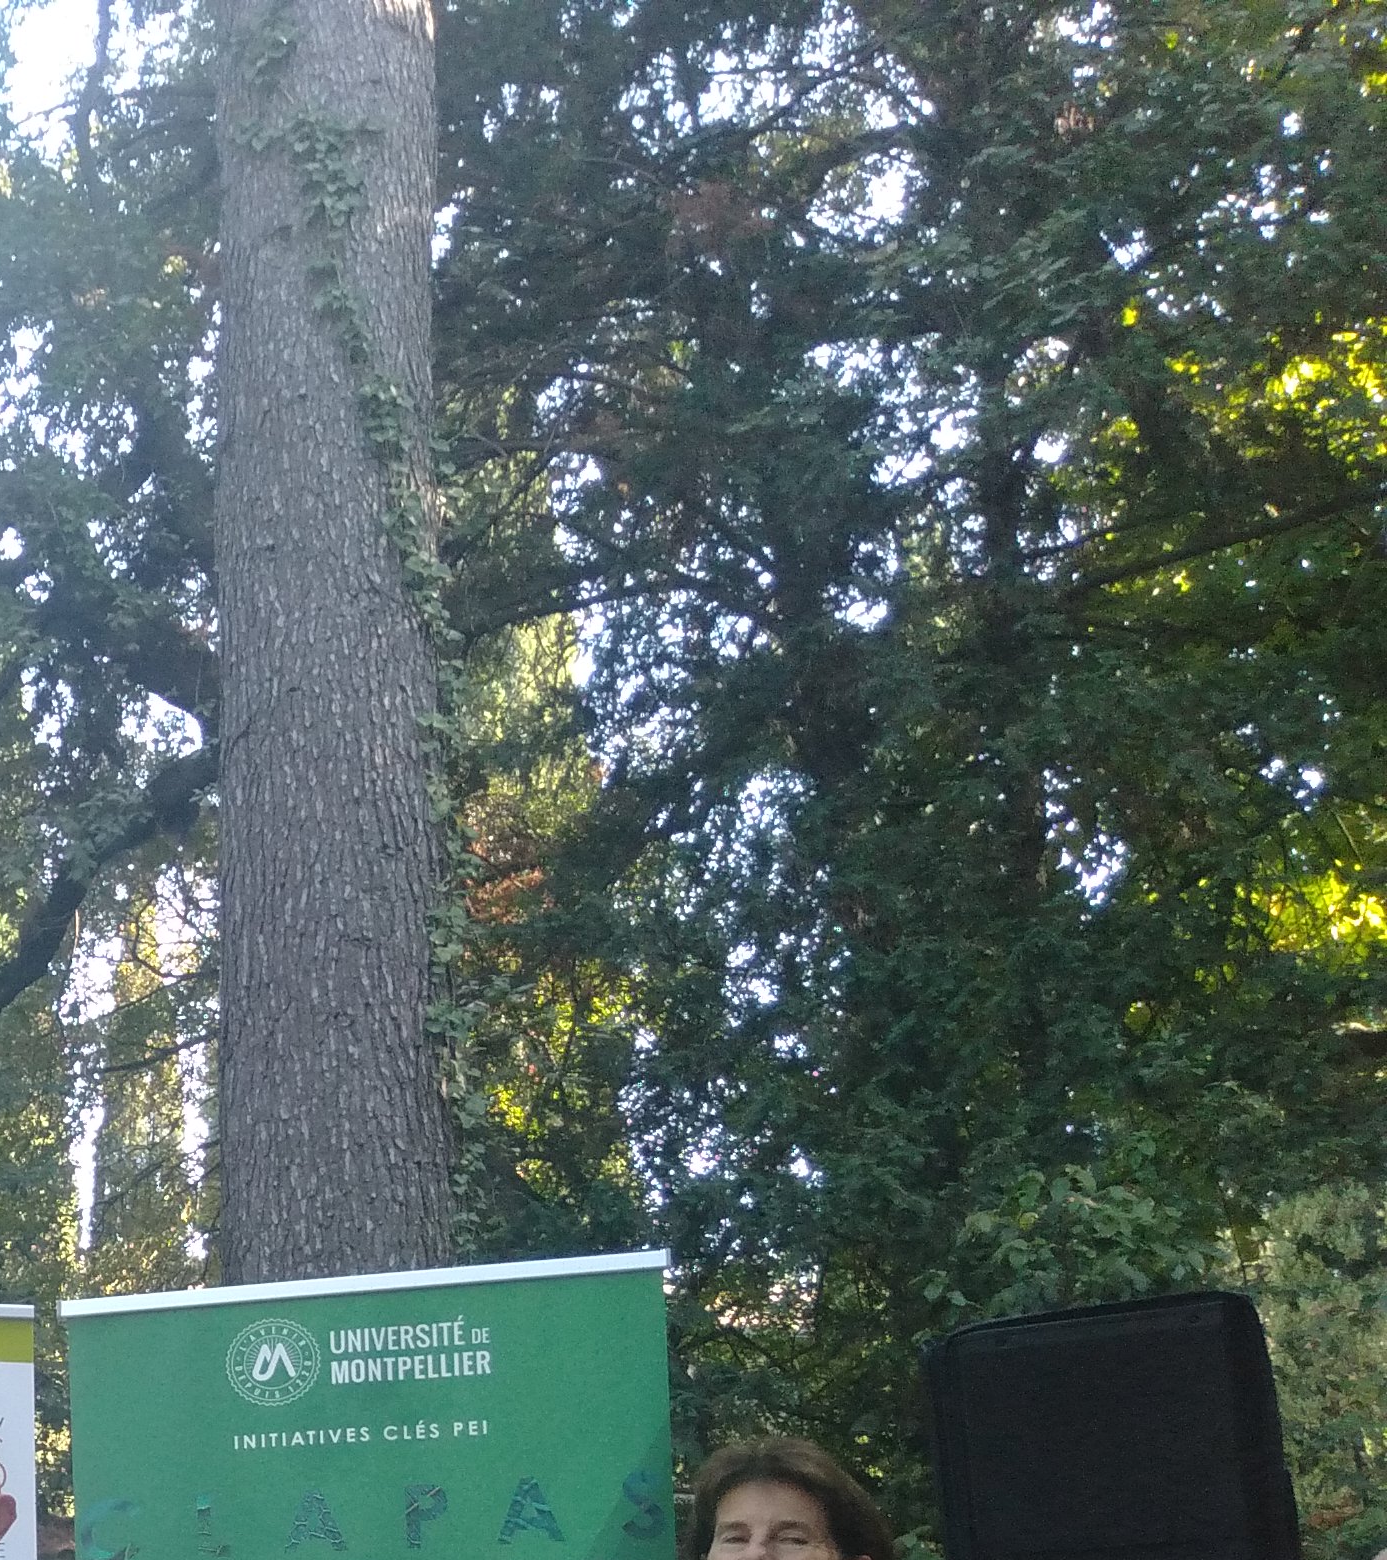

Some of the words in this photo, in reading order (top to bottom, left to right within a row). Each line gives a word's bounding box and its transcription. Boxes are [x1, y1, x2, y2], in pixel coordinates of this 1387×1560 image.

[330, 1315, 466, 1354] UNIVERSITÉ
[471, 1328, 490, 1344] DE
[331, 1351, 492, 1385] MONTPELLIER
[234, 1427, 371, 1450] INITIATIVES
[383, 1420, 440, 1441] CLÉS
[453, 1420, 488, 1436] PEI
